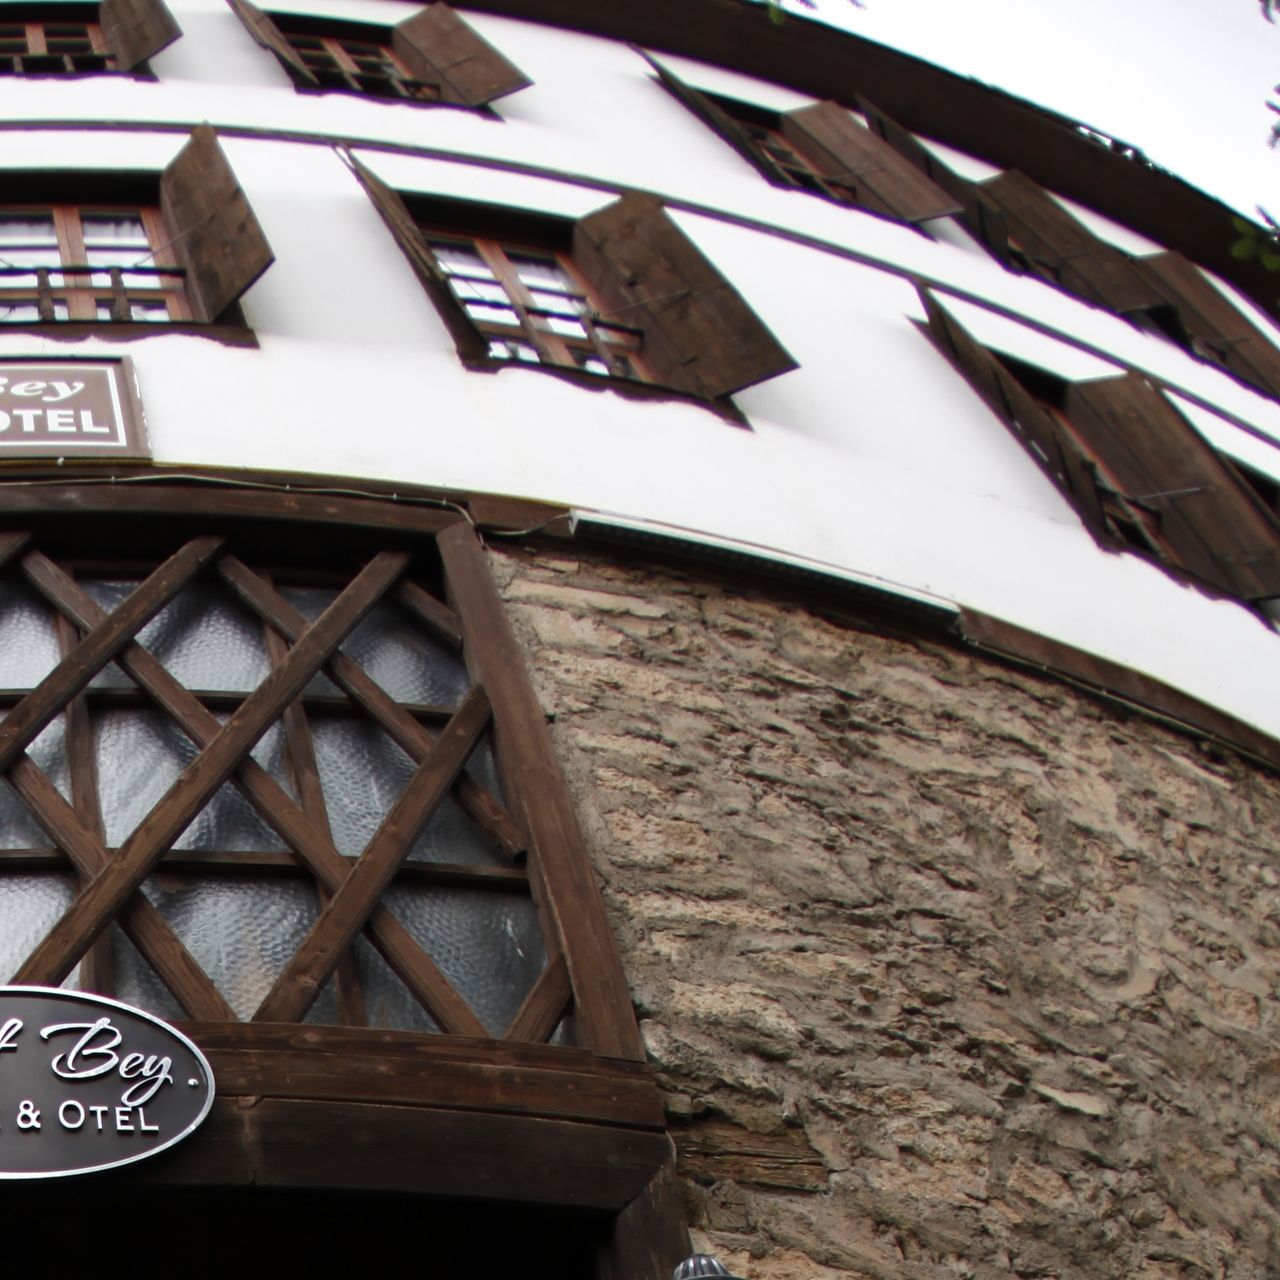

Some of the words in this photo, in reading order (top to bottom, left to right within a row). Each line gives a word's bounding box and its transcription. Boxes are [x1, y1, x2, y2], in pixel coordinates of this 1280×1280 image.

[39, 1017, 173, 1107] Bey
[16, 1100, 41, 1130] &
[58, 1100, 160, 1132] OTEL
